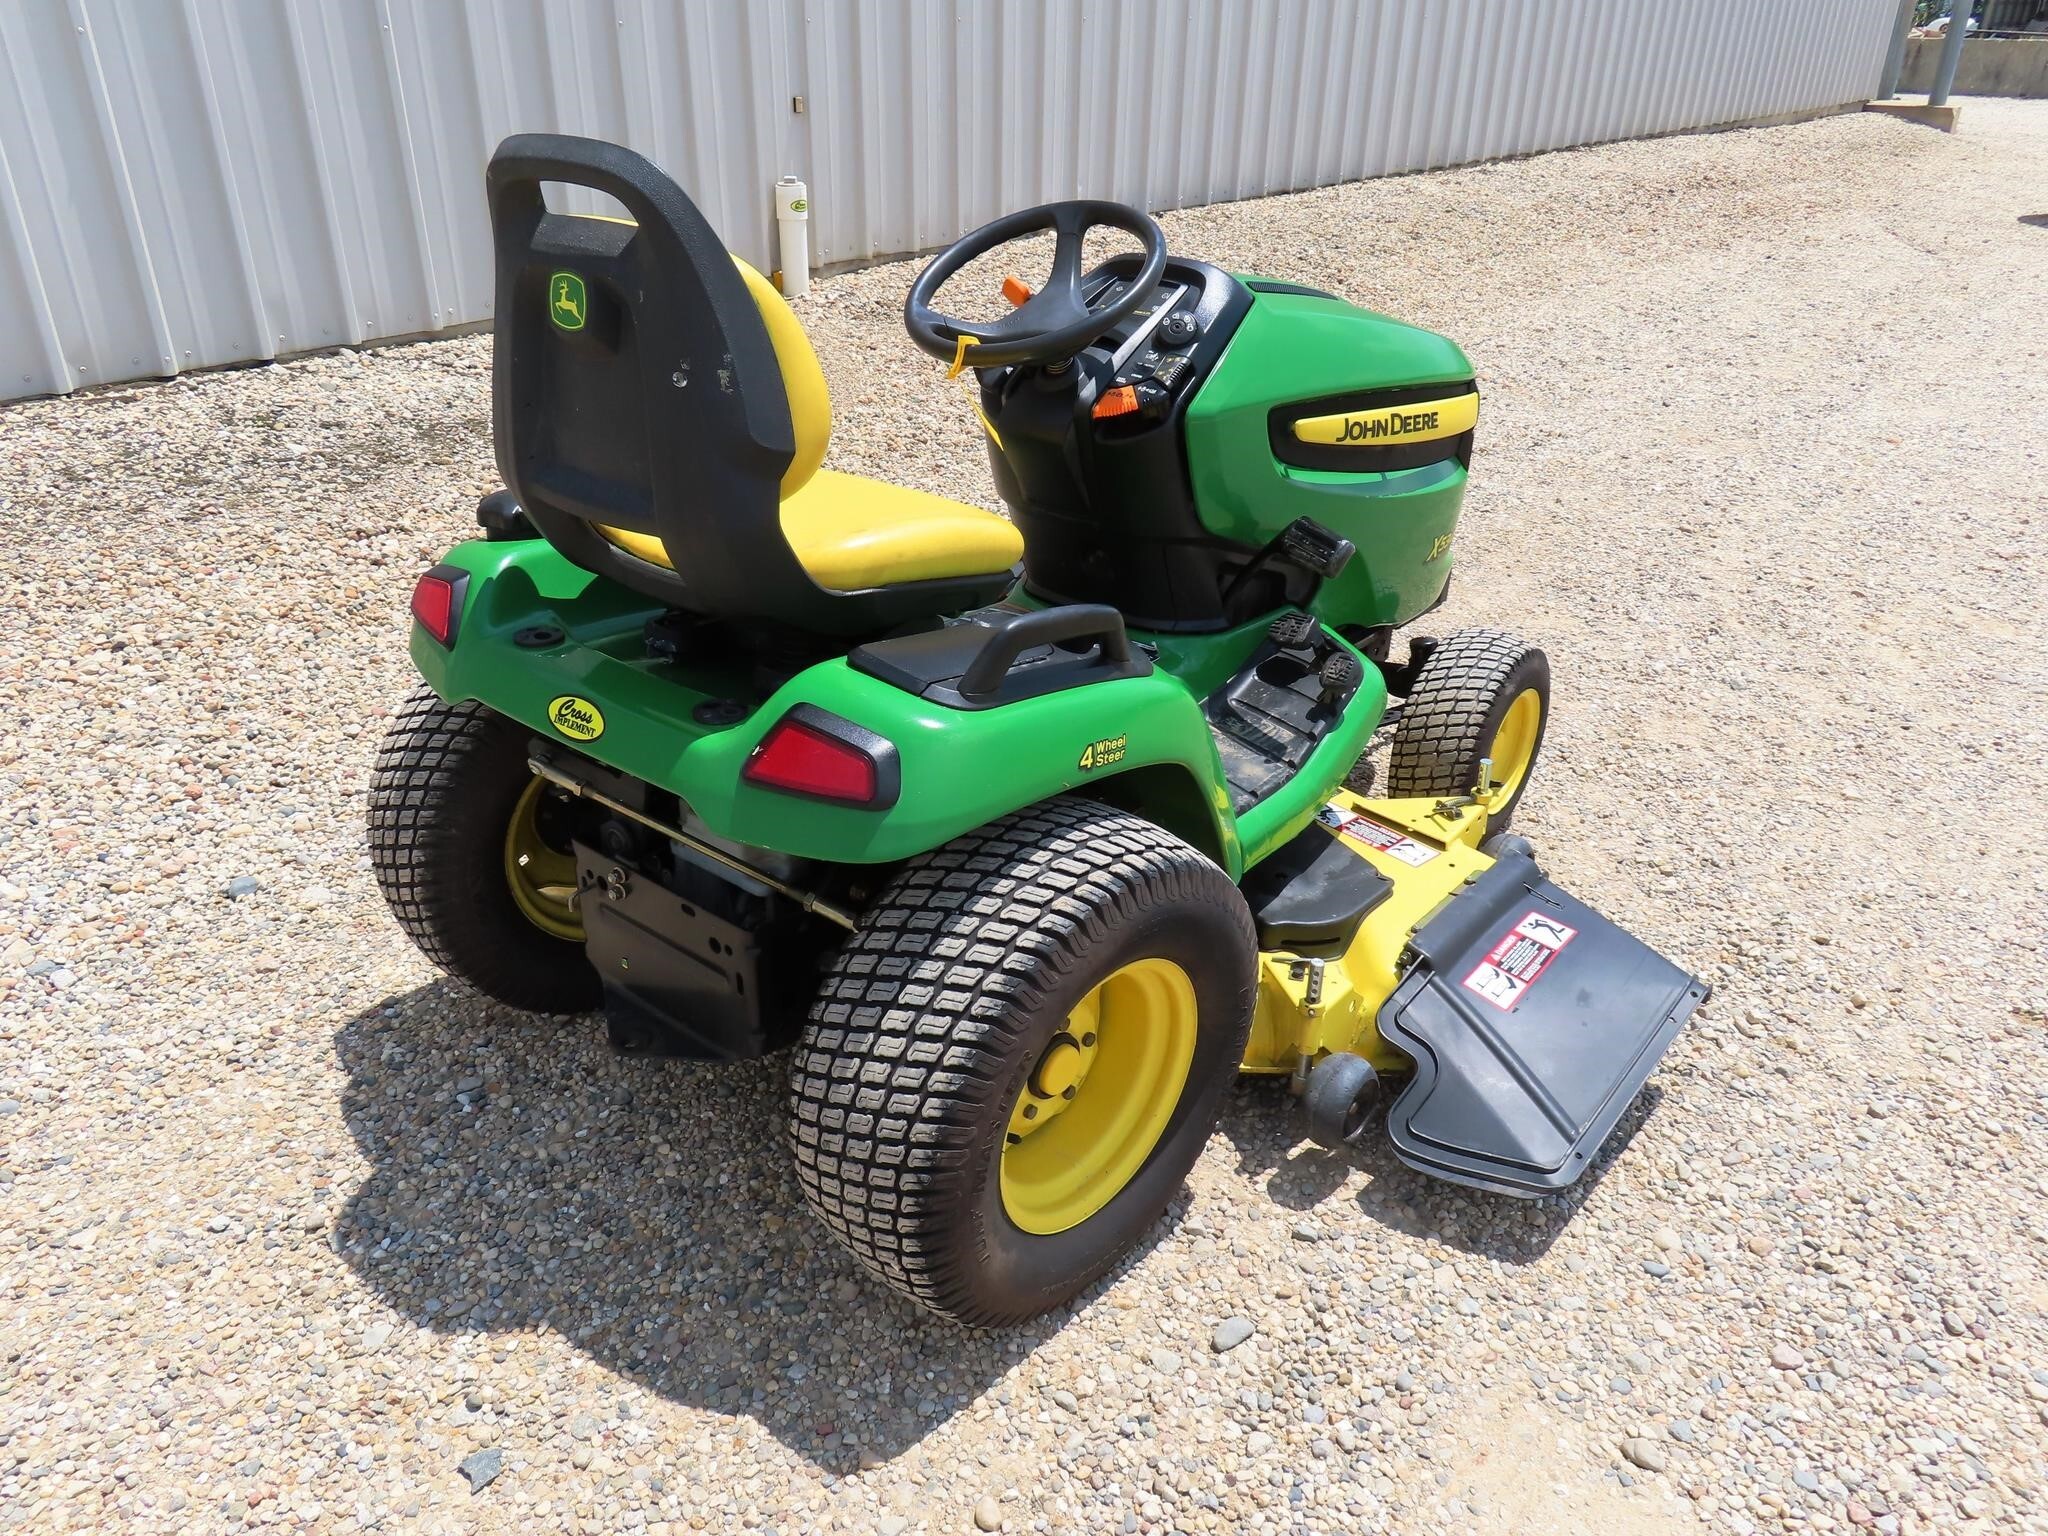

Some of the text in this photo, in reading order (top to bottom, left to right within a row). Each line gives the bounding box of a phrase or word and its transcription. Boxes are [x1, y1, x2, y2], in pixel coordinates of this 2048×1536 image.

[1336, 411, 1439, 443] JOHN DEERE
[557, 698, 593, 724] Cross
[553, 713, 596, 738] IMPLEMENT
[1079, 733, 1127, 769] 4 Wheel
[1096, 748, 1126, 767] Steer
